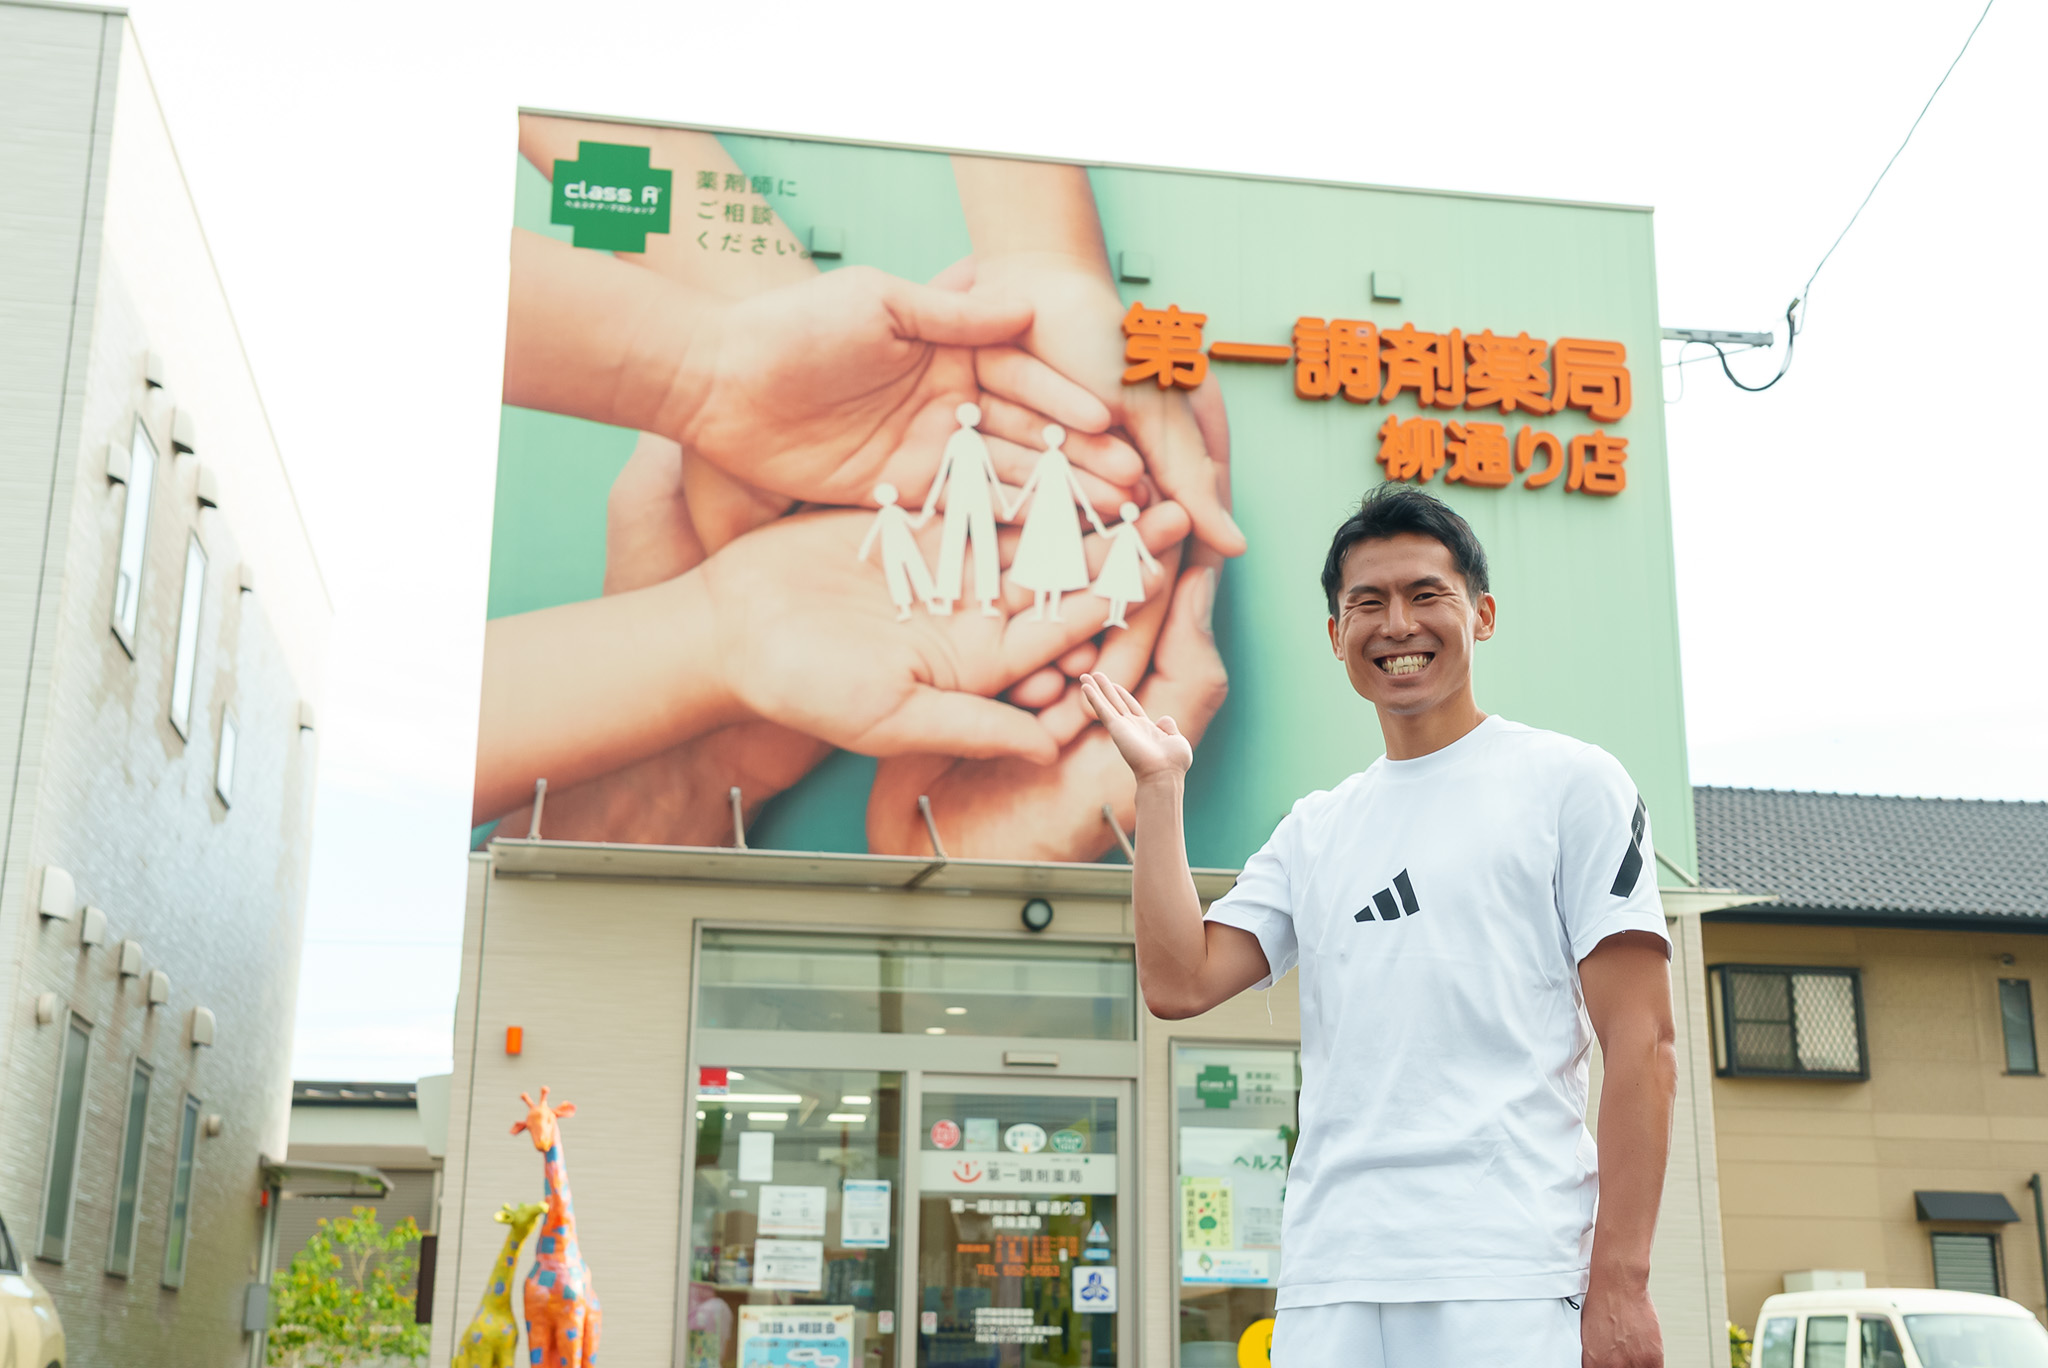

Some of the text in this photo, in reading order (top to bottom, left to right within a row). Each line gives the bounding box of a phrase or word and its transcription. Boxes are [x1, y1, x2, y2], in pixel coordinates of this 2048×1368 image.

[564, 180, 632, 203] class
[697, 170, 798, 197] 薬剤師に
[698, 201, 774, 226] ご相談
[1120, 301, 1632, 423] 第一調剤薬局
[1376, 413, 1629, 496] 柳通り店
[986, 1168, 1083, 1184] 第一調剤薬局
